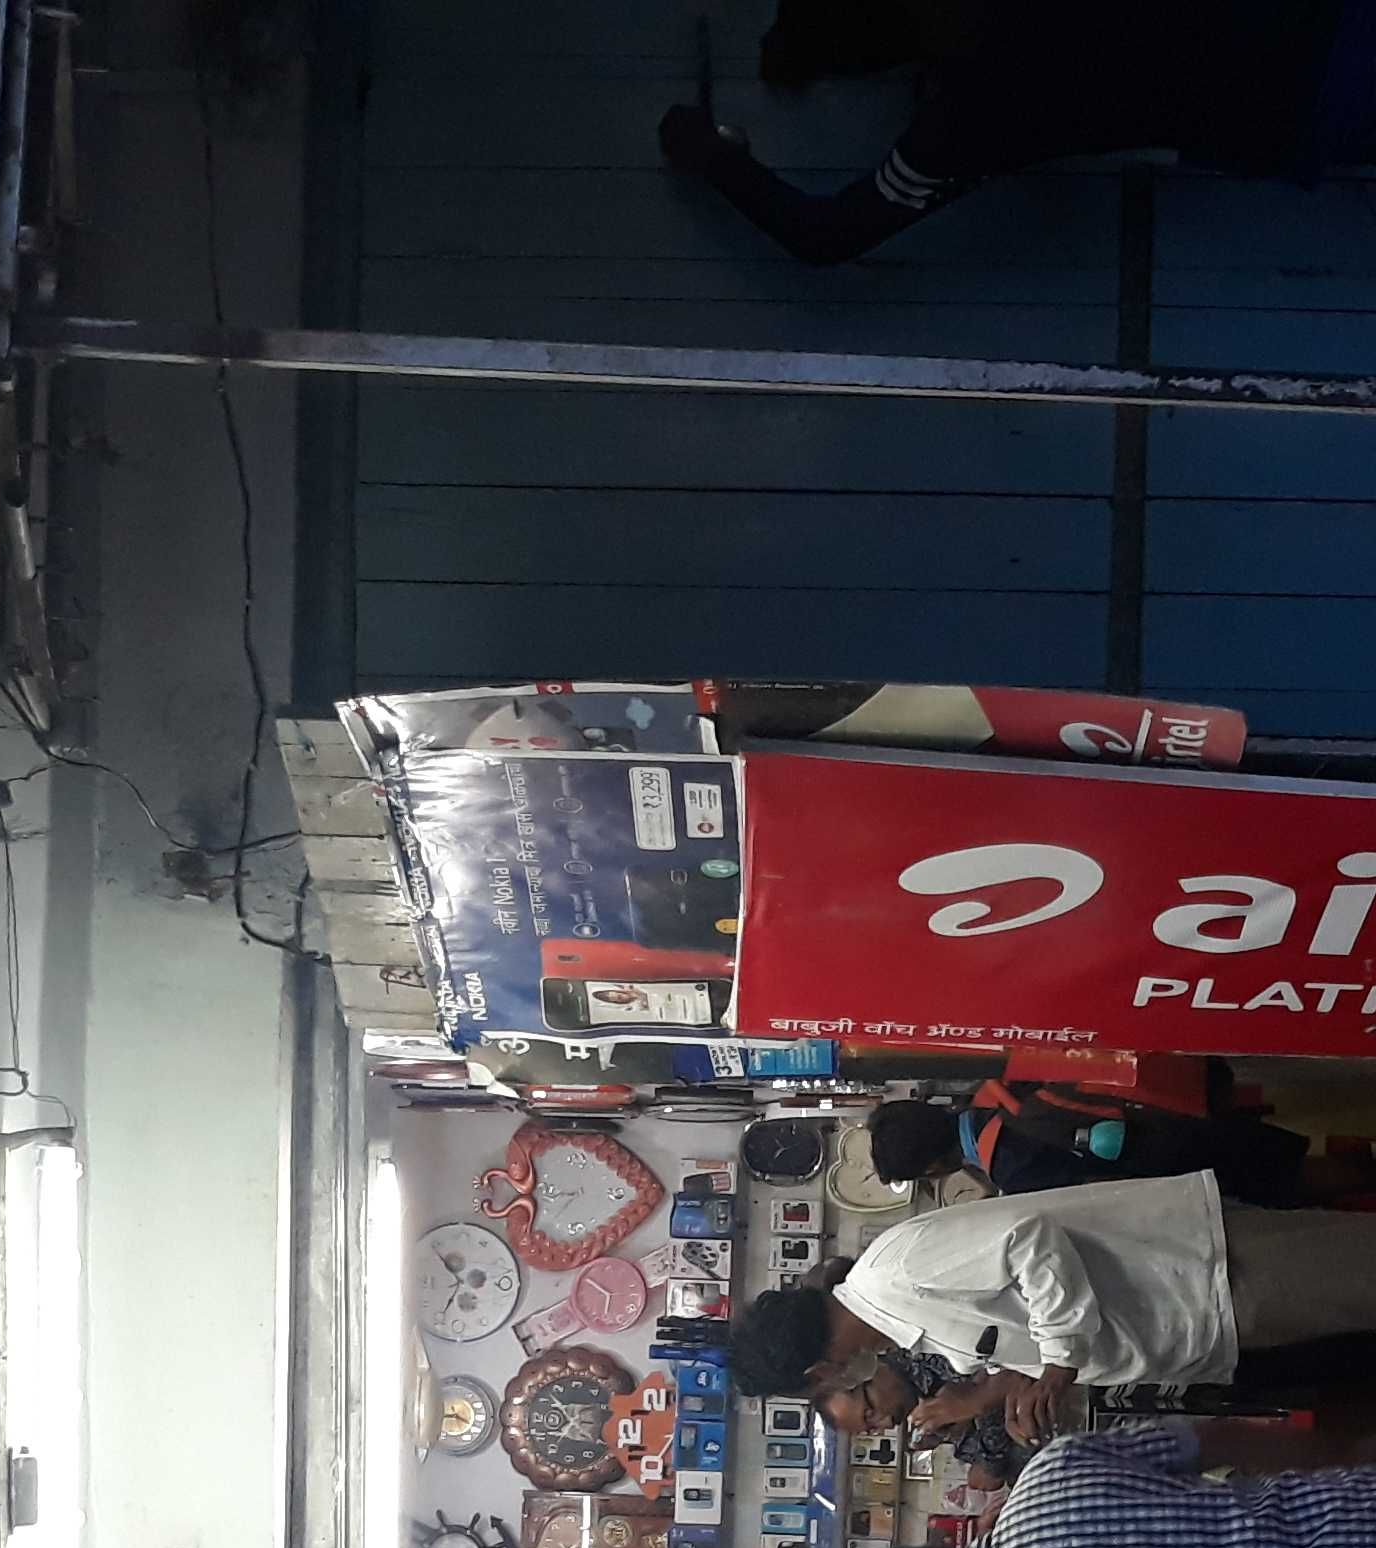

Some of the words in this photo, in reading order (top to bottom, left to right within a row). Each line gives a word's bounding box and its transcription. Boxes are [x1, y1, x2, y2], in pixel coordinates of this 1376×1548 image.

[491, 866, 515, 904] Nokia
[463, 970, 490, 1020] NOKIA
[642, 1386, 667, 1410] 2
[617, 1415, 643, 1449] 12
[639, 1453, 665, 1483] 10
